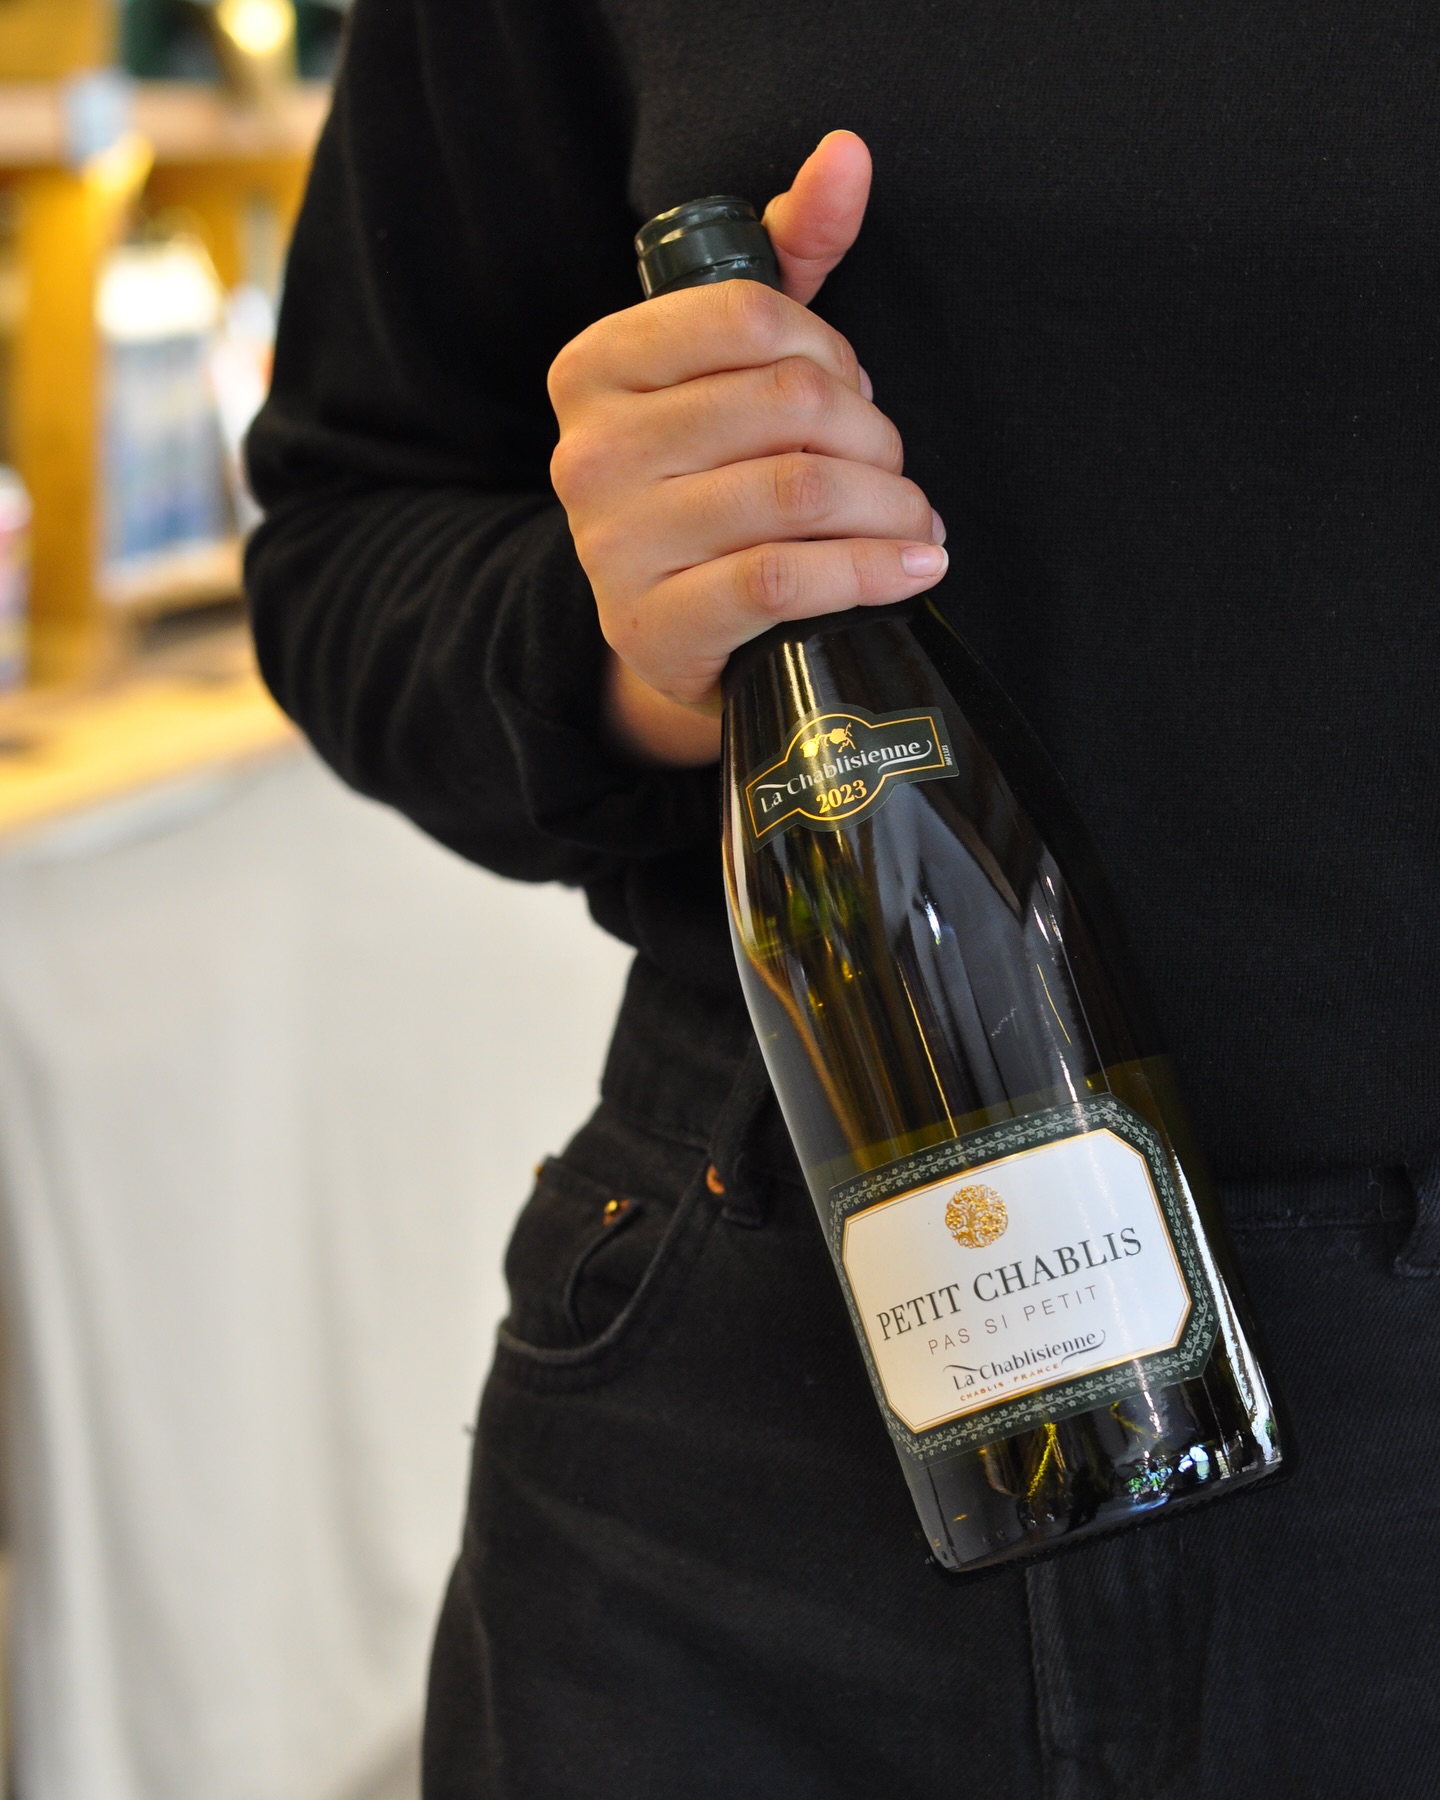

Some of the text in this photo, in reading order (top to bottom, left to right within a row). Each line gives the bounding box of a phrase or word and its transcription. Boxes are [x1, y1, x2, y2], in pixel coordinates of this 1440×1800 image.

[760, 791, 783, 814] La
[786, 741, 921, 795] Chablisienne
[815, 779, 867, 814] 2023
[876, 1227, 1142, 1341] PETIT CHABLIS
[928, 1285, 1098, 1355] PAS SI PETIT
[952, 1333, 1096, 1390] La Chablisienne
[960, 1362, 1060, 1402] CHABLIS FRANCE
